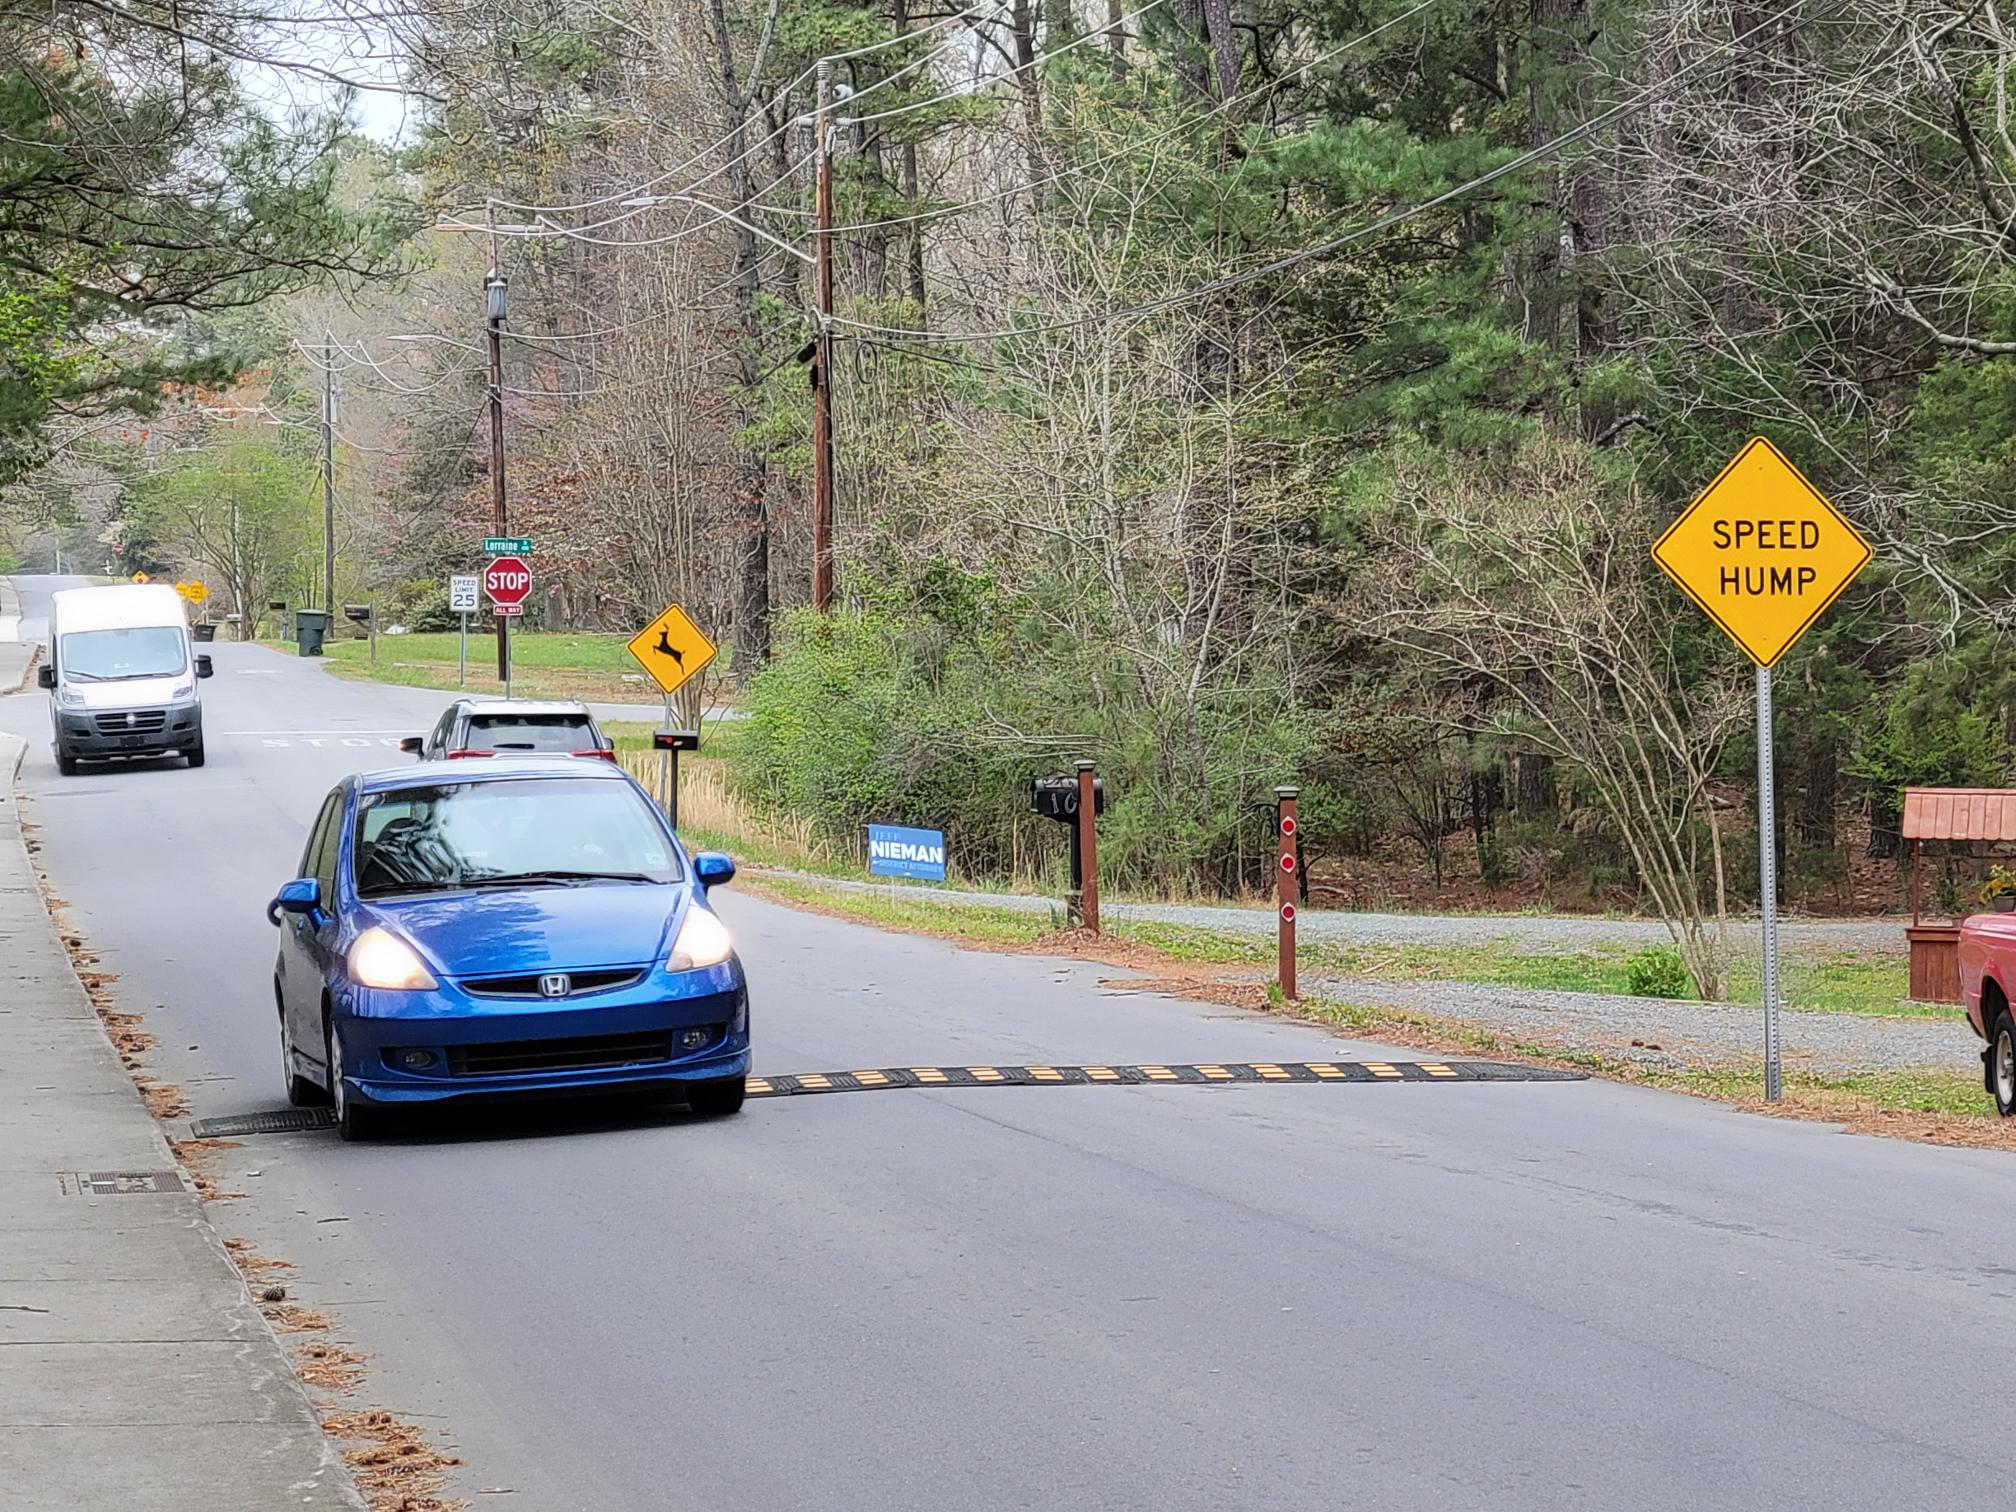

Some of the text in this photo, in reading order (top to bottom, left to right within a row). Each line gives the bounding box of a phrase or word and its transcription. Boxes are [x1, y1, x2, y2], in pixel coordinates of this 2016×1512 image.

[485, 539, 518, 551] Lorraine
[1713, 520, 1820, 549] SPEED
[487, 572, 529, 590] STOP
[1720, 566, 1817, 595] HUMP
[453, 594, 475, 607] 25
[870, 840, 943, 864] NIEMAN
